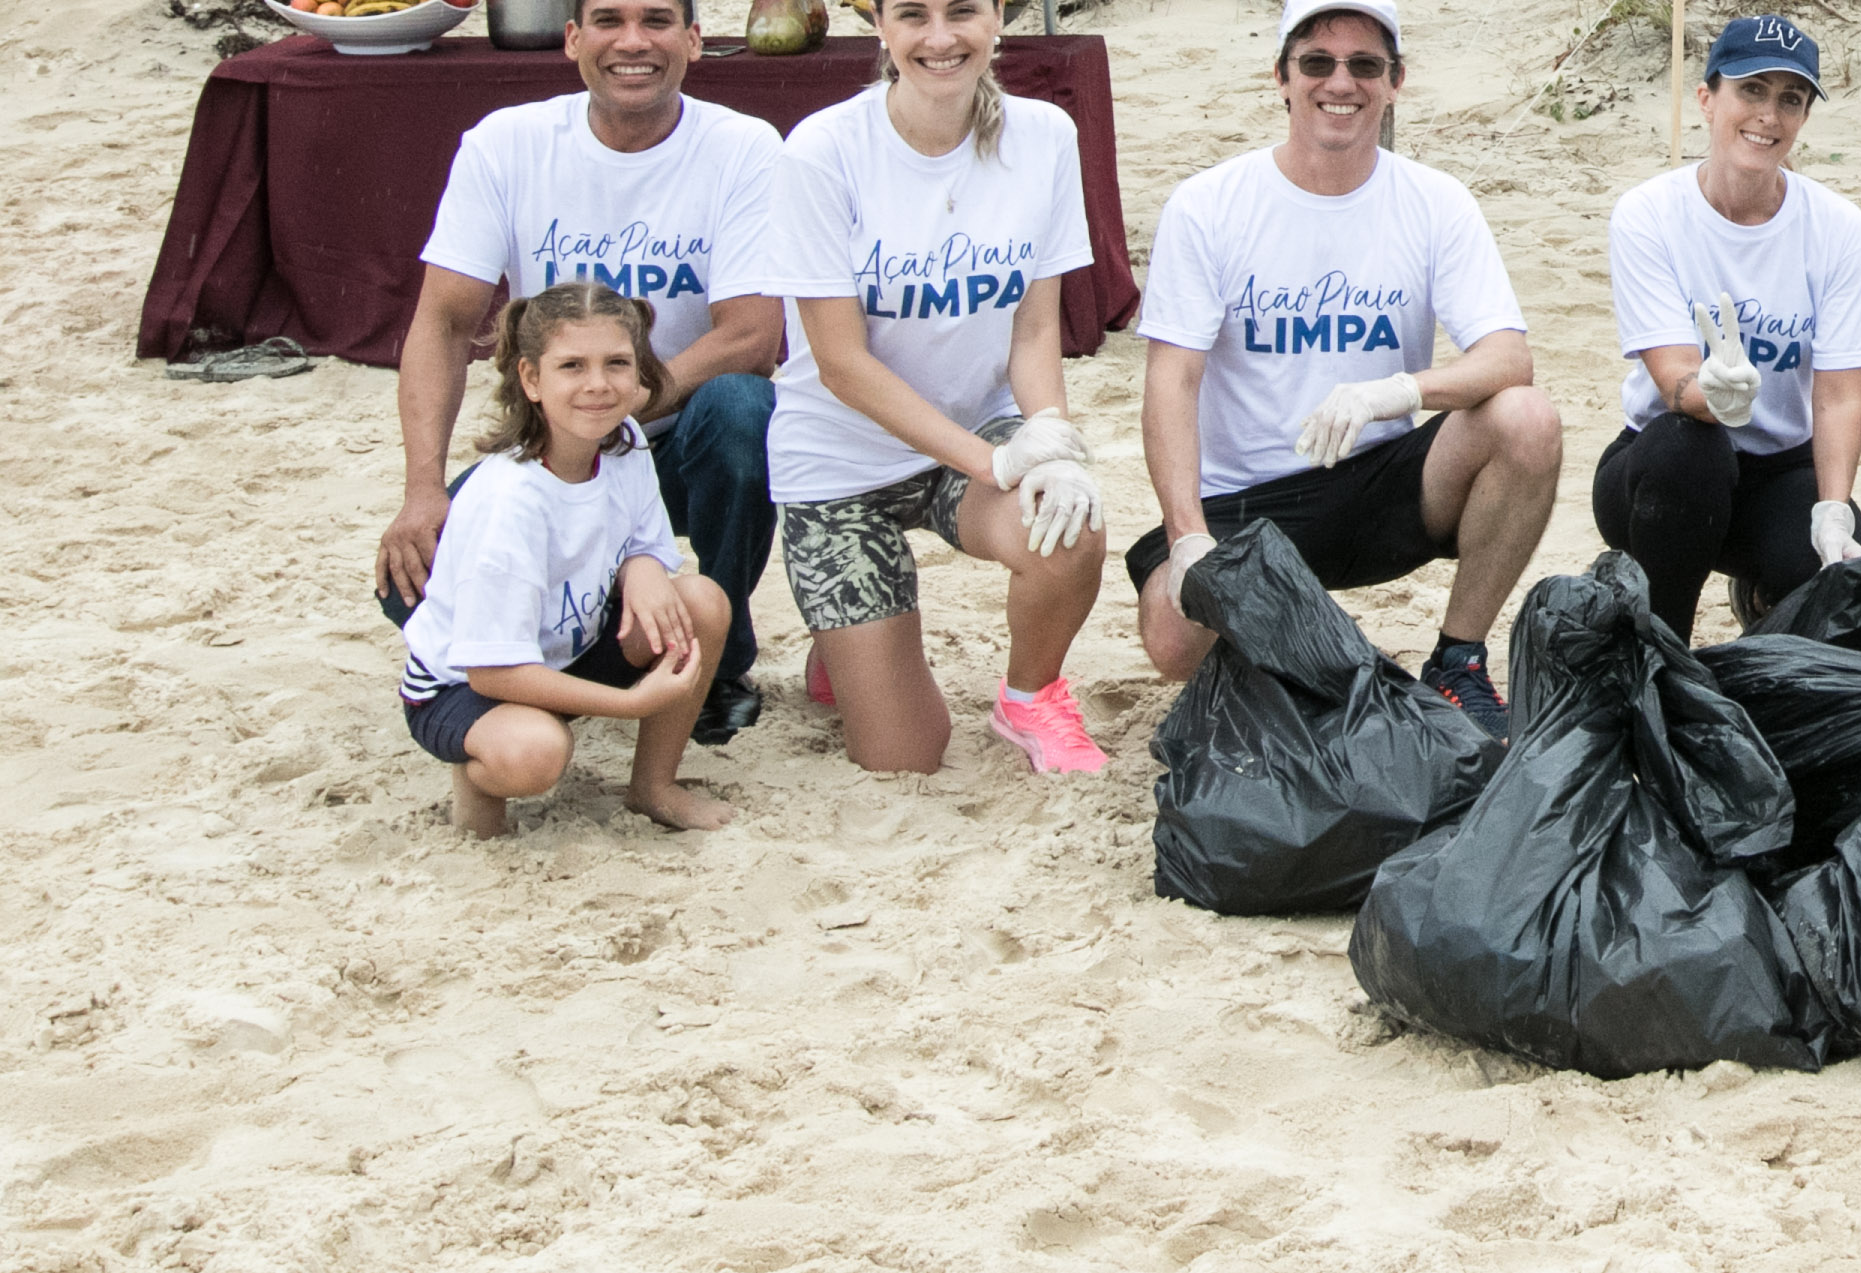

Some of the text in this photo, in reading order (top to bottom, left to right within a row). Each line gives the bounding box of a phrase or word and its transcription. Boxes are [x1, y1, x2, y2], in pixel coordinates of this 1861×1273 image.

[531, 218, 713, 277] Ação Praia
[853, 232, 1038, 300] Ação Praia
[866, 269, 1025, 320] LIMPA
[1233, 270, 1412, 332] Ação Praia
[1733, 298, 1816, 339] Praia
[1244, 314, 1401, 354] LIMPA
